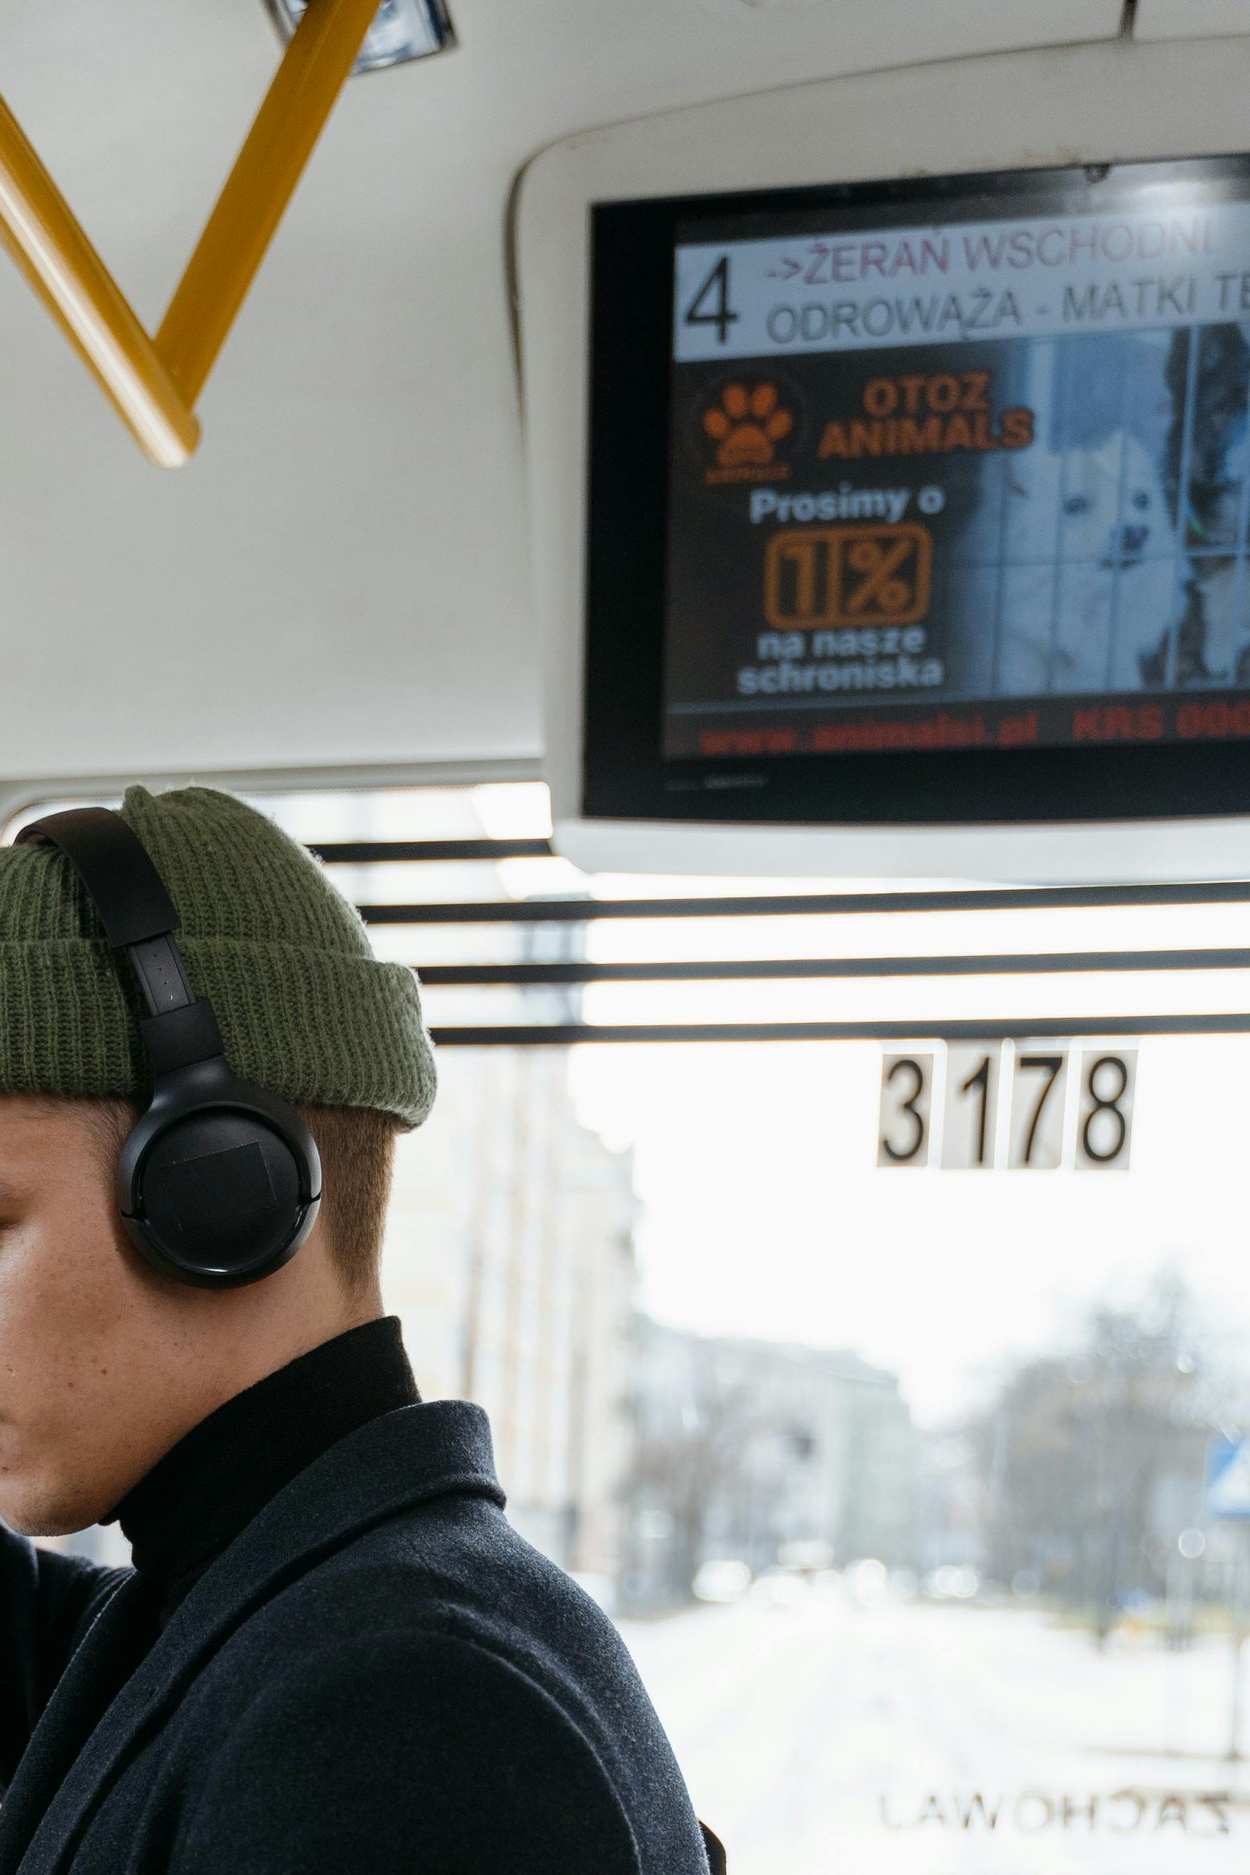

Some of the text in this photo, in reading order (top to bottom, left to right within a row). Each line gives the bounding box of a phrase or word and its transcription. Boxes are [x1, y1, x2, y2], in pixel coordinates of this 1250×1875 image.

[961, 218, 1215, 272] WSCHODNI
[684, 254, 738, 346] 4
[766, 285, 1022, 344] ODROWĄŻA
[1061, 274, 1197, 323] MATKI
[863, 373, 991, 417] OTOZ
[816, 408, 1034, 461] ANIMALS
[750, 483, 945, 524] Prosimy o
[757, 626, 926, 660] na nasze
[736, 653, 945, 695] schroniska
[882, 1055, 1129, 1165] 3178
